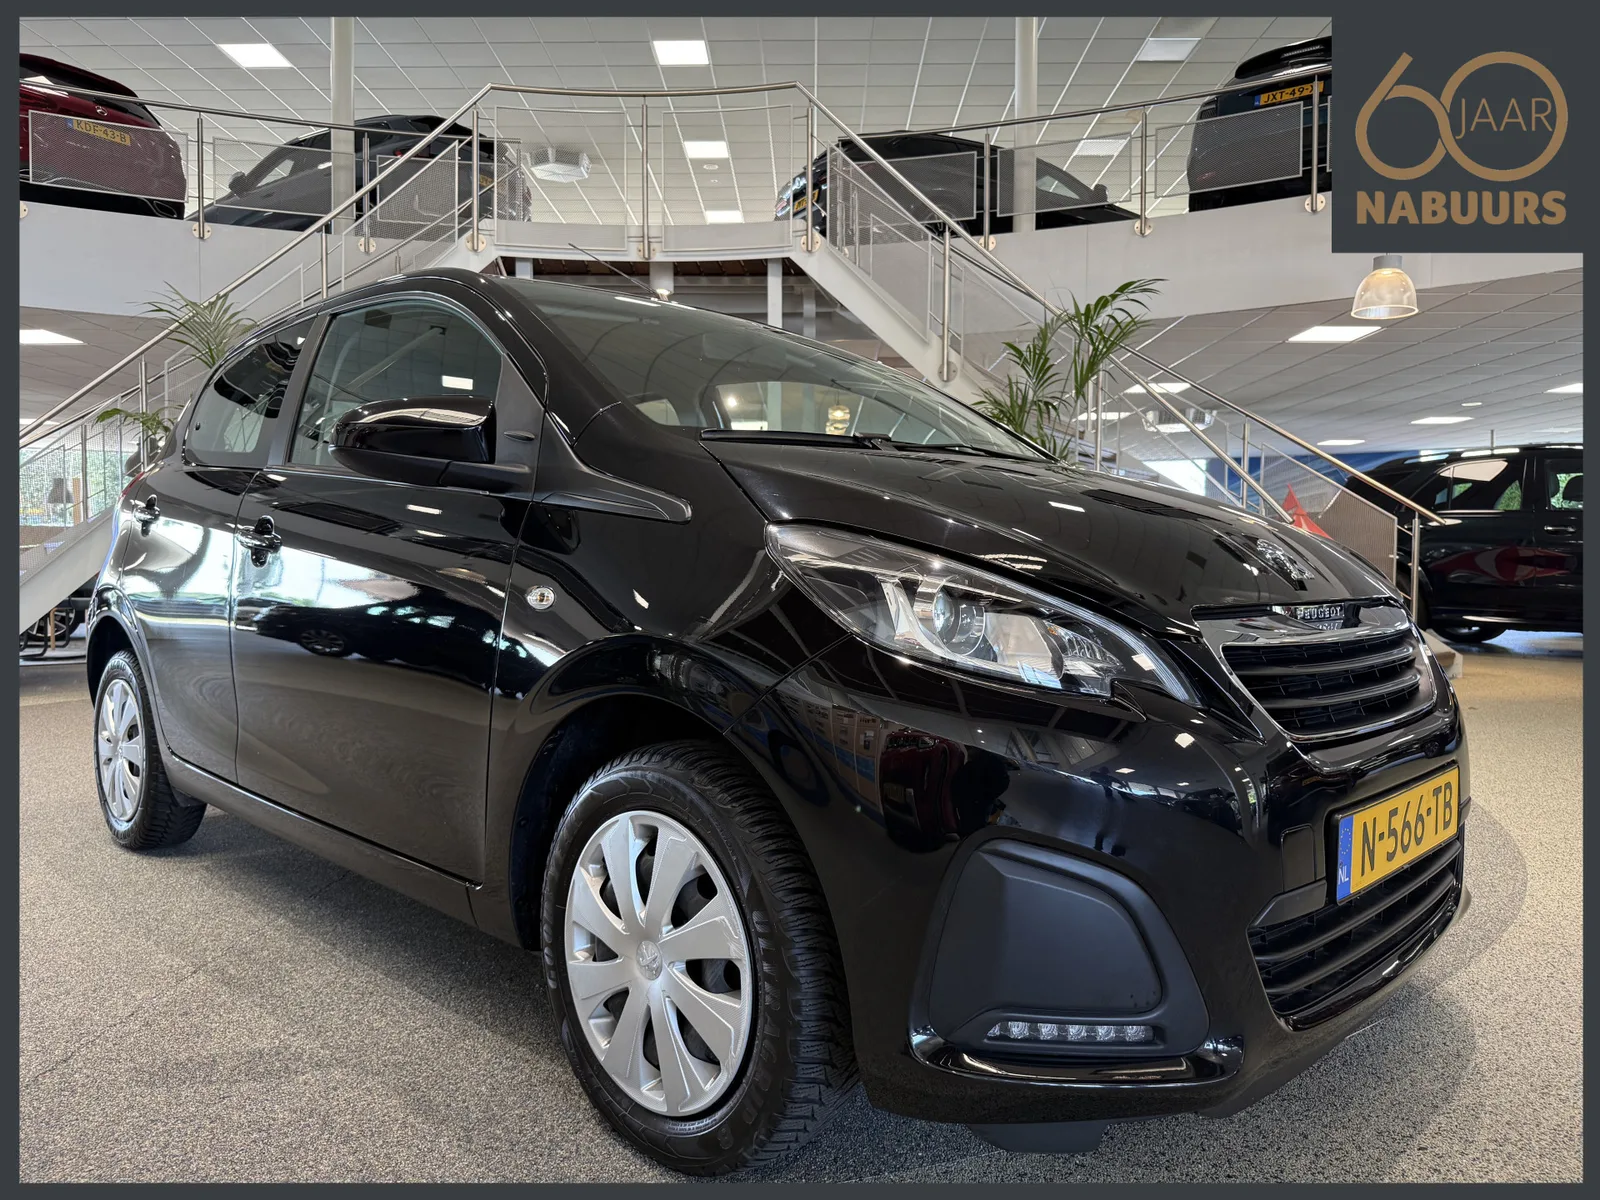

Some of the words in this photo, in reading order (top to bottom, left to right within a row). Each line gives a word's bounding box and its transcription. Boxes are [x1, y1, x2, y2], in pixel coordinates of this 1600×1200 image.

[76, 119, 127, 143] KDF-43-B
[1296, 606, 1341, 620] PEUGEOT
[1360, 781, 1453, 877] N-566-TB
[1337, 866, 1349, 885] NL
